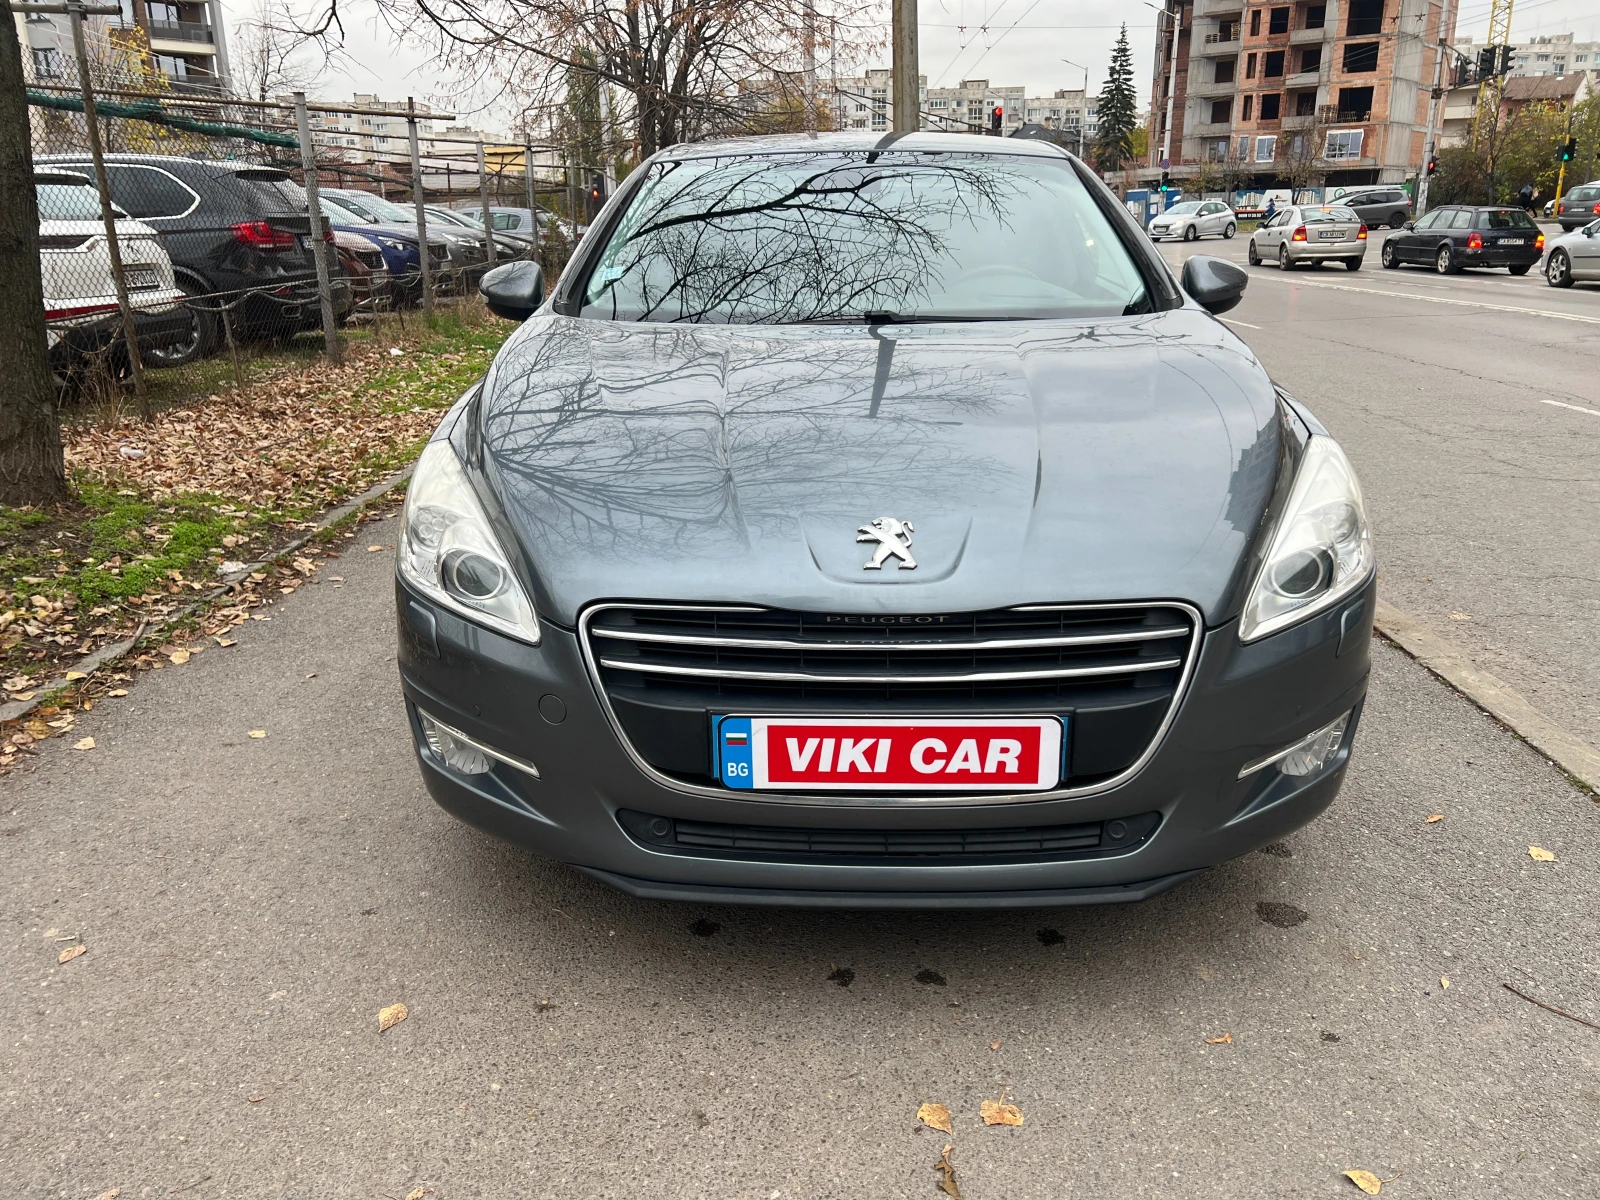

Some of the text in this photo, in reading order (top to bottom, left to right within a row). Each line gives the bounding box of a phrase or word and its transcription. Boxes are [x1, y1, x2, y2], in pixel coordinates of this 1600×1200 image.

[826, 615, 949, 624] PEUGEOT
[785, 737, 1022, 774] VIKI CAR
[727, 762, 748, 777] BG
